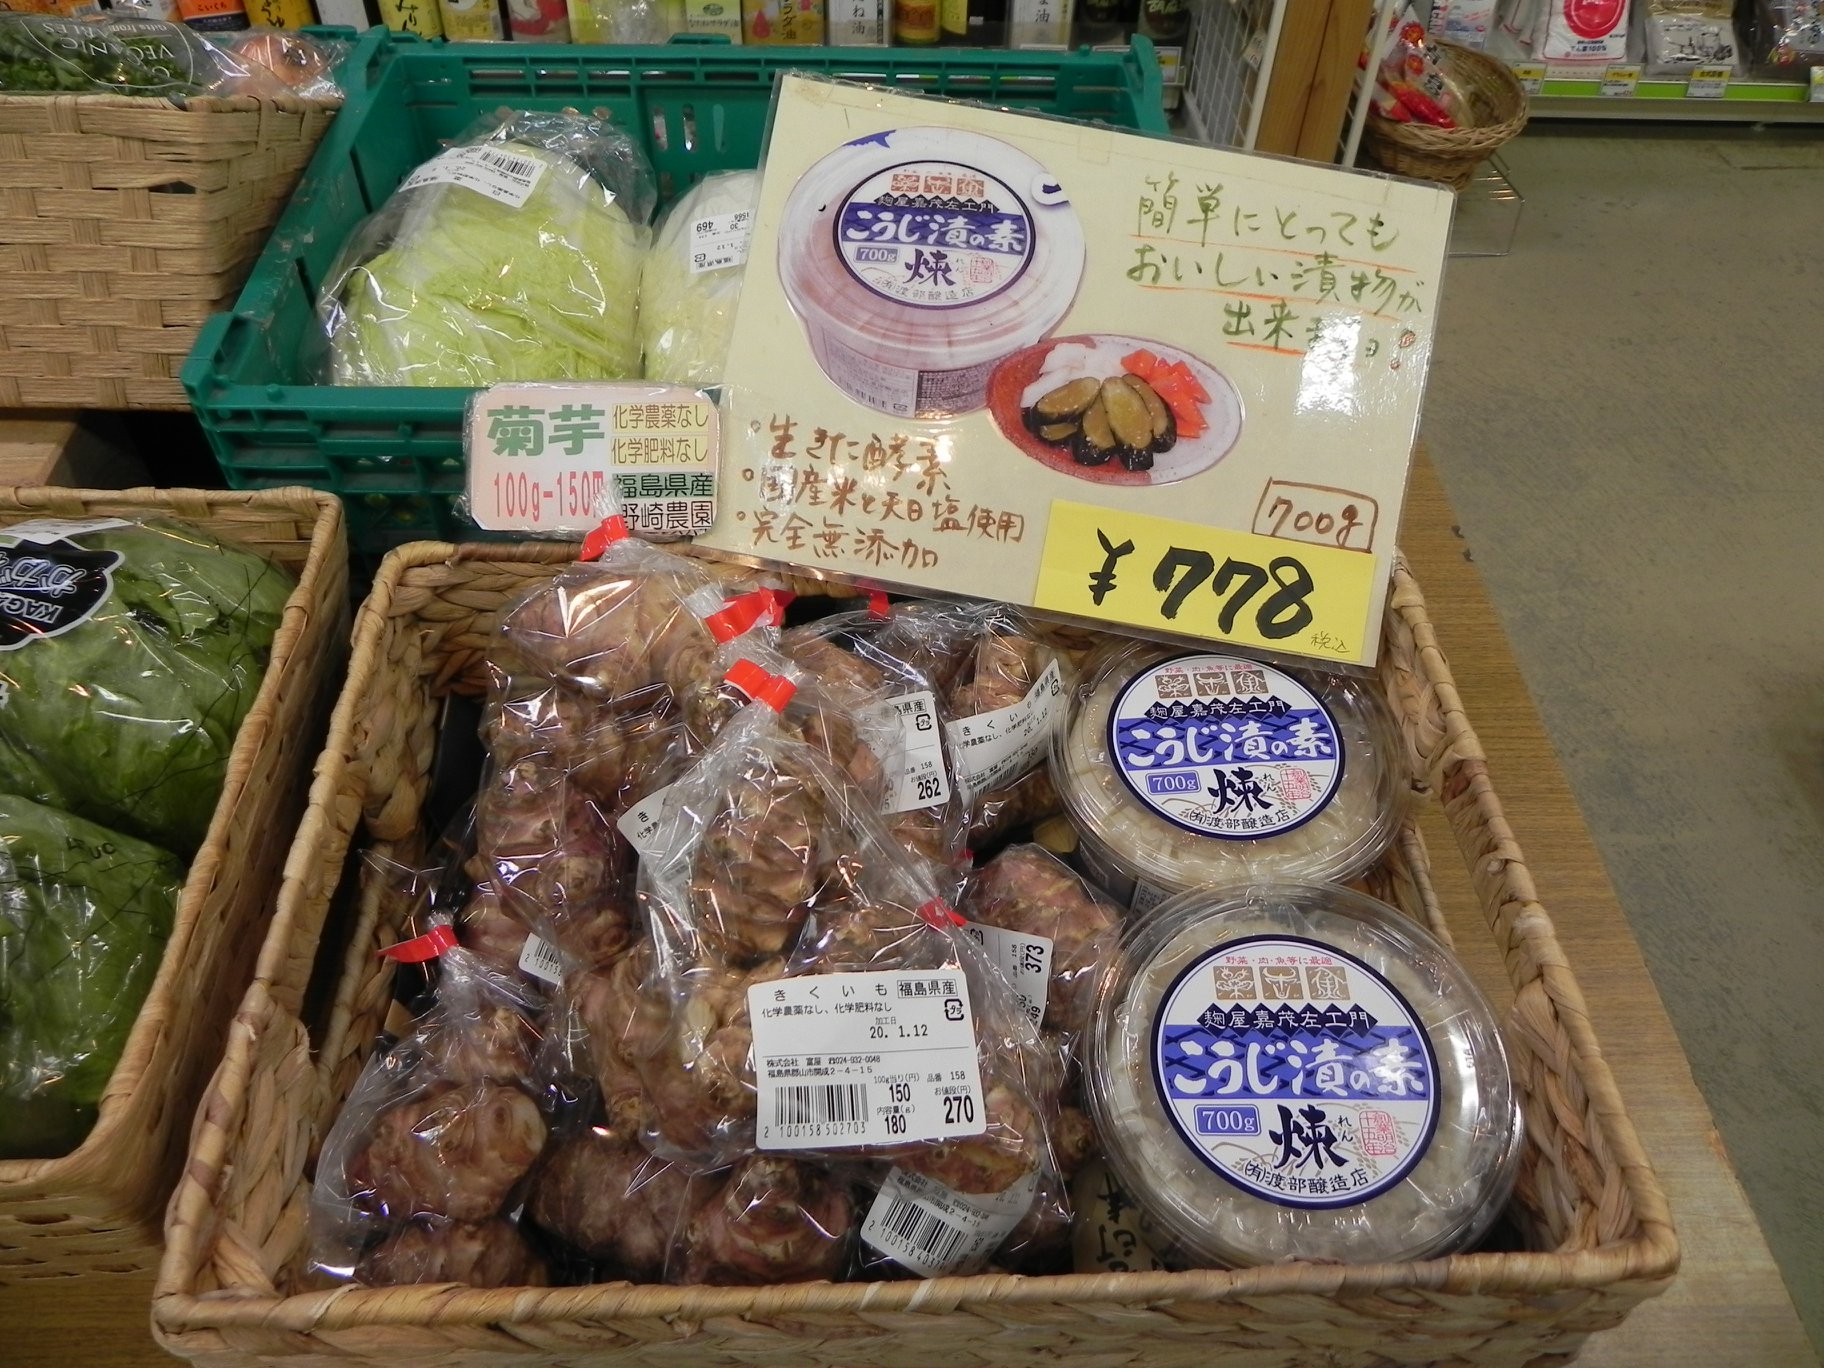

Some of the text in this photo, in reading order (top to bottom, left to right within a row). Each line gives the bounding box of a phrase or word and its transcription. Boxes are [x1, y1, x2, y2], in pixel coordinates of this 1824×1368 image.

[781, 0, 797, 40] ラダ油
[852, 0, 865, 35] ね油
[1137, 171, 1399, 250] 簡単にとっても
[846, 210, 1025, 252] こうじ漬の素
[860, 248, 896, 262] 700g
[1126, 244, 1425, 316] おいしい漬物が
[487, 404, 605, 457] 菊芋
[613, 404, 709, 430] 化学農薬なし
[611, 437, 708, 464] 化学肥料なし
[614, 473, 713, 498] 福島県産
[621, 501, 713, 531] 野崎農園
[1268, 496, 1364, 547] 700g
[753, 506, 939, 568] 完全無添加
[1128, 718, 1331, 766] こうじ漬の素
[917, 778, 941, 801] 262
[1153, 775, 1197, 792] 700g
[1025, 944, 1044, 973] 373
[899, 981, 957, 997] 福島県産
[950, 1071, 965, 1080] 158
[1174, 1038, 1424, 1096] こうじ漬の素
[889, 1083, 911, 1102] 150
[943, 1095, 974, 1124] 270
[1202, 1110, 1255, 1131] 700g
[884, 1115, 906, 1134] 180
